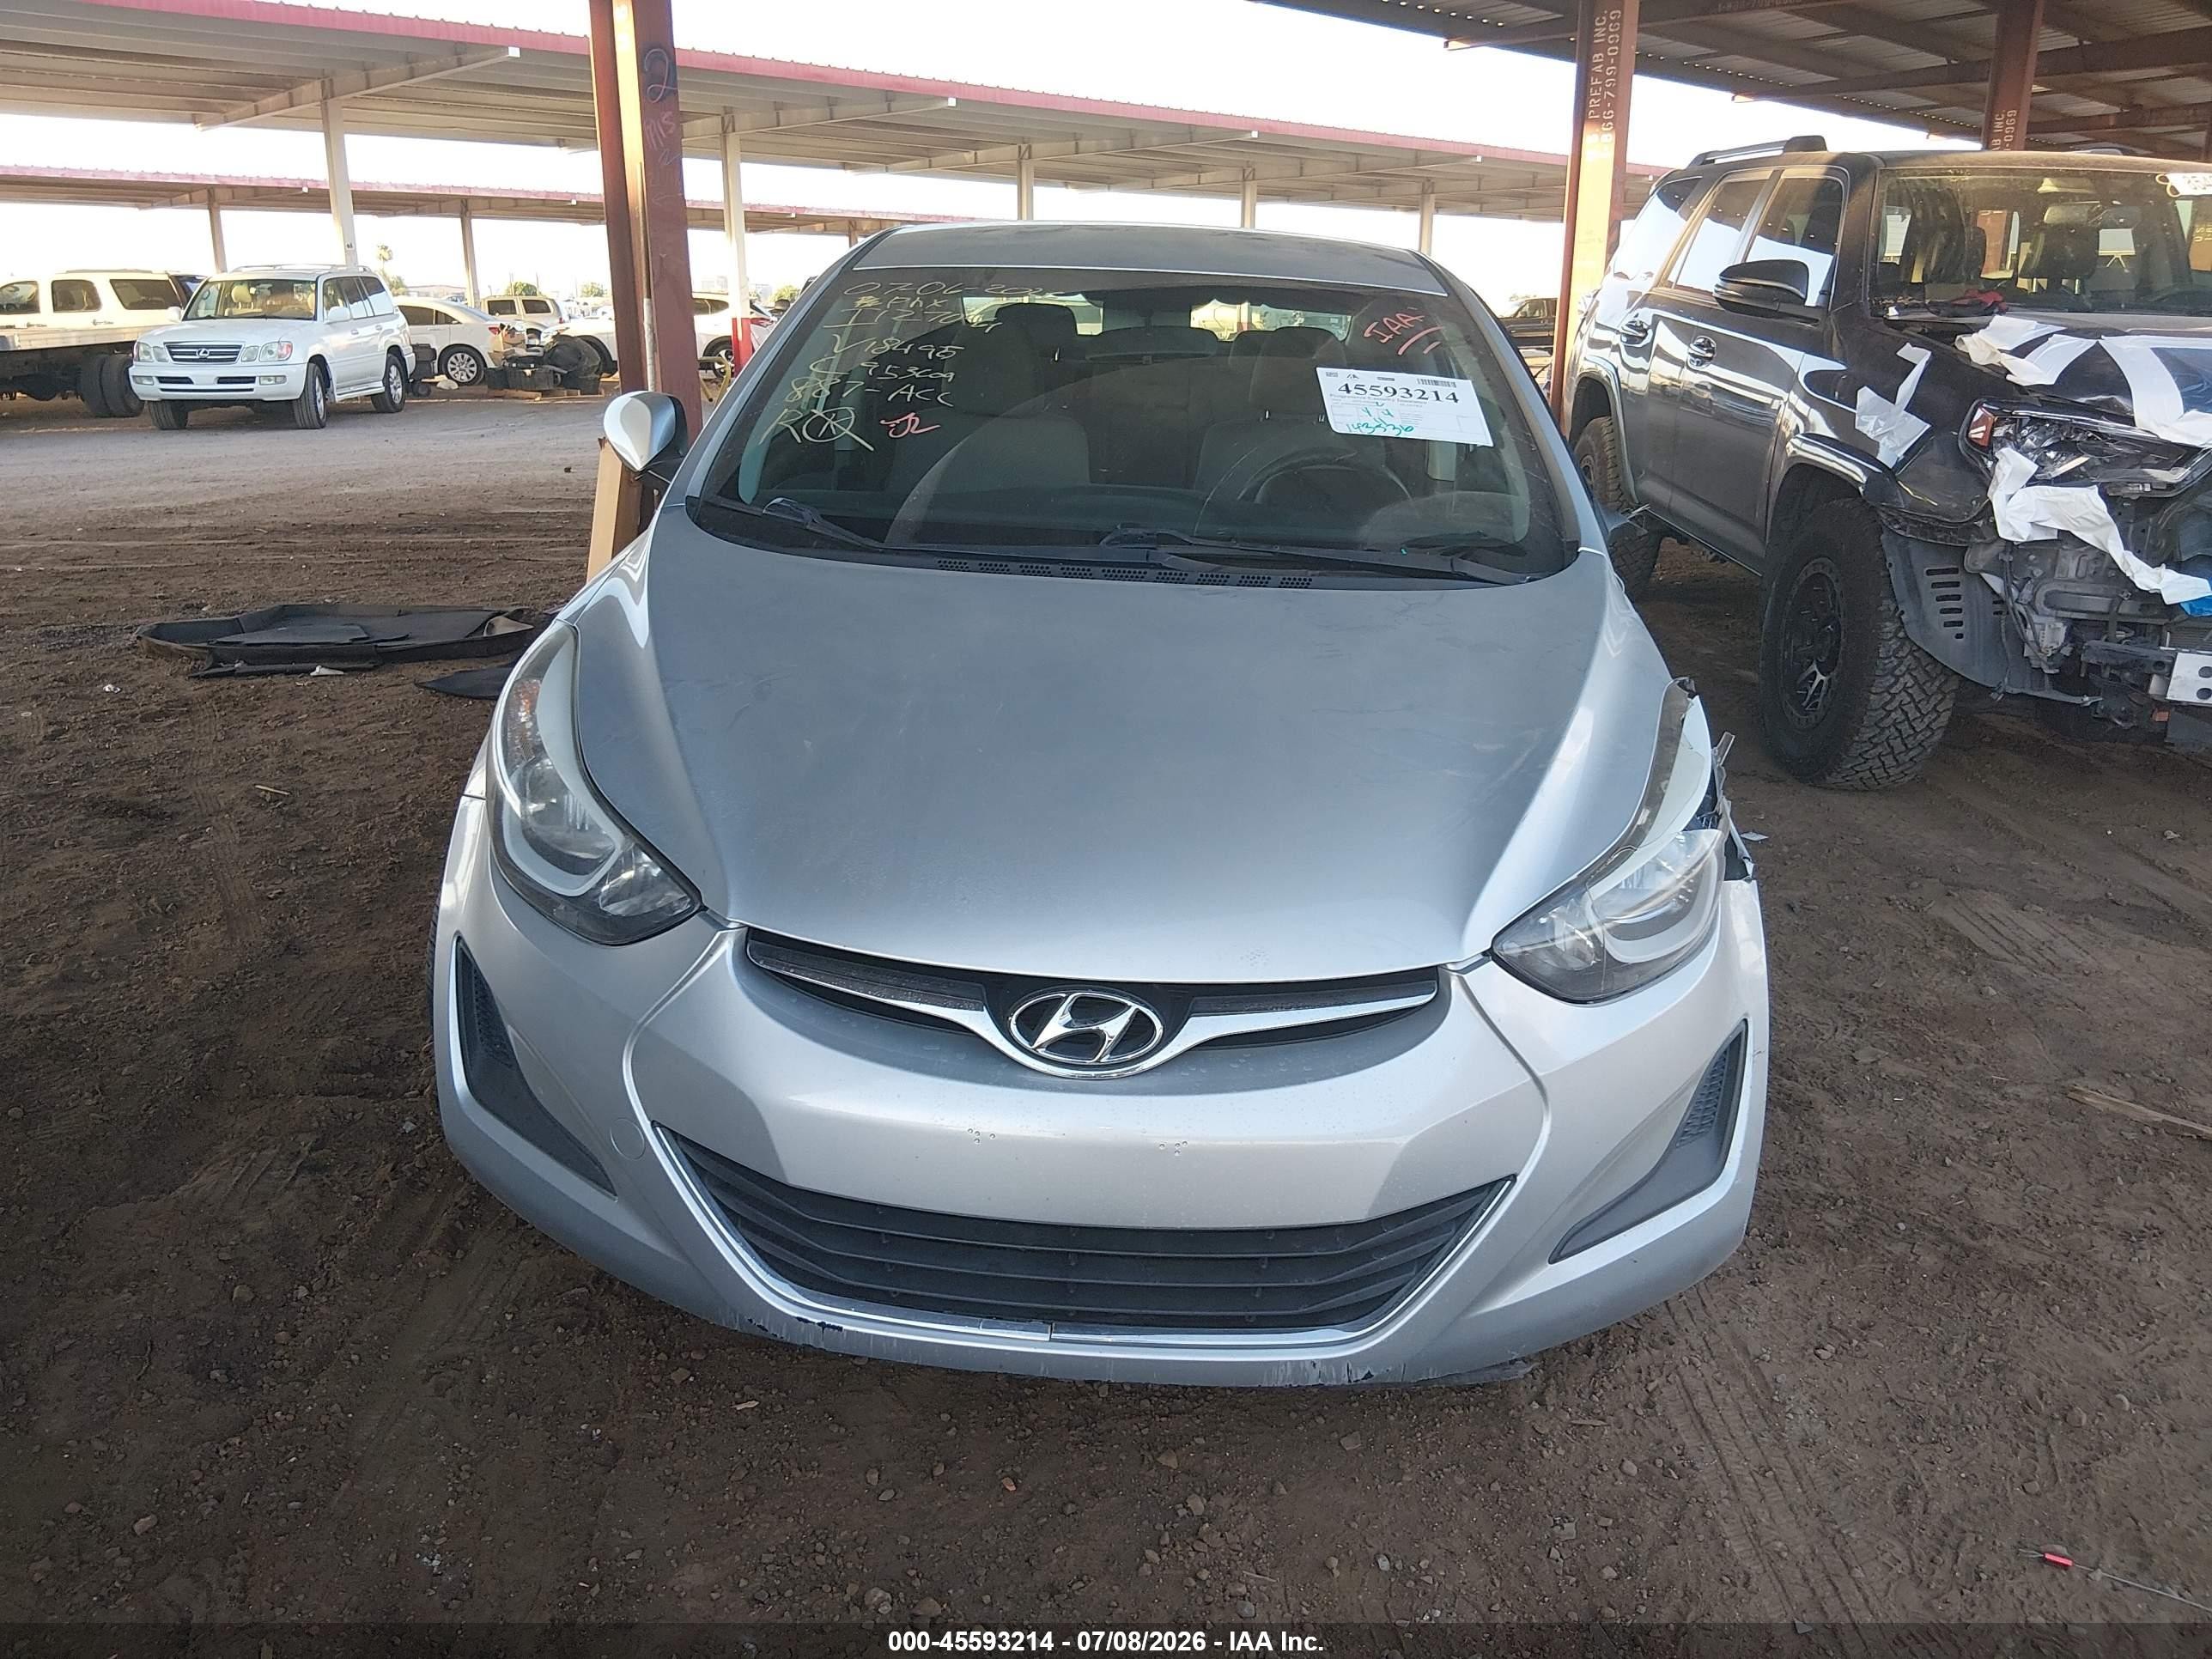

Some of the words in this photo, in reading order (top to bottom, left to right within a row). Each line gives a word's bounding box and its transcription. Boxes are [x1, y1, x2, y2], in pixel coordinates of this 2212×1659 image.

[1593, 9, 1607, 43] INC.
[1589, 52, 1604, 119] PREFAB
[1338, 383, 1459, 404] 45593214
